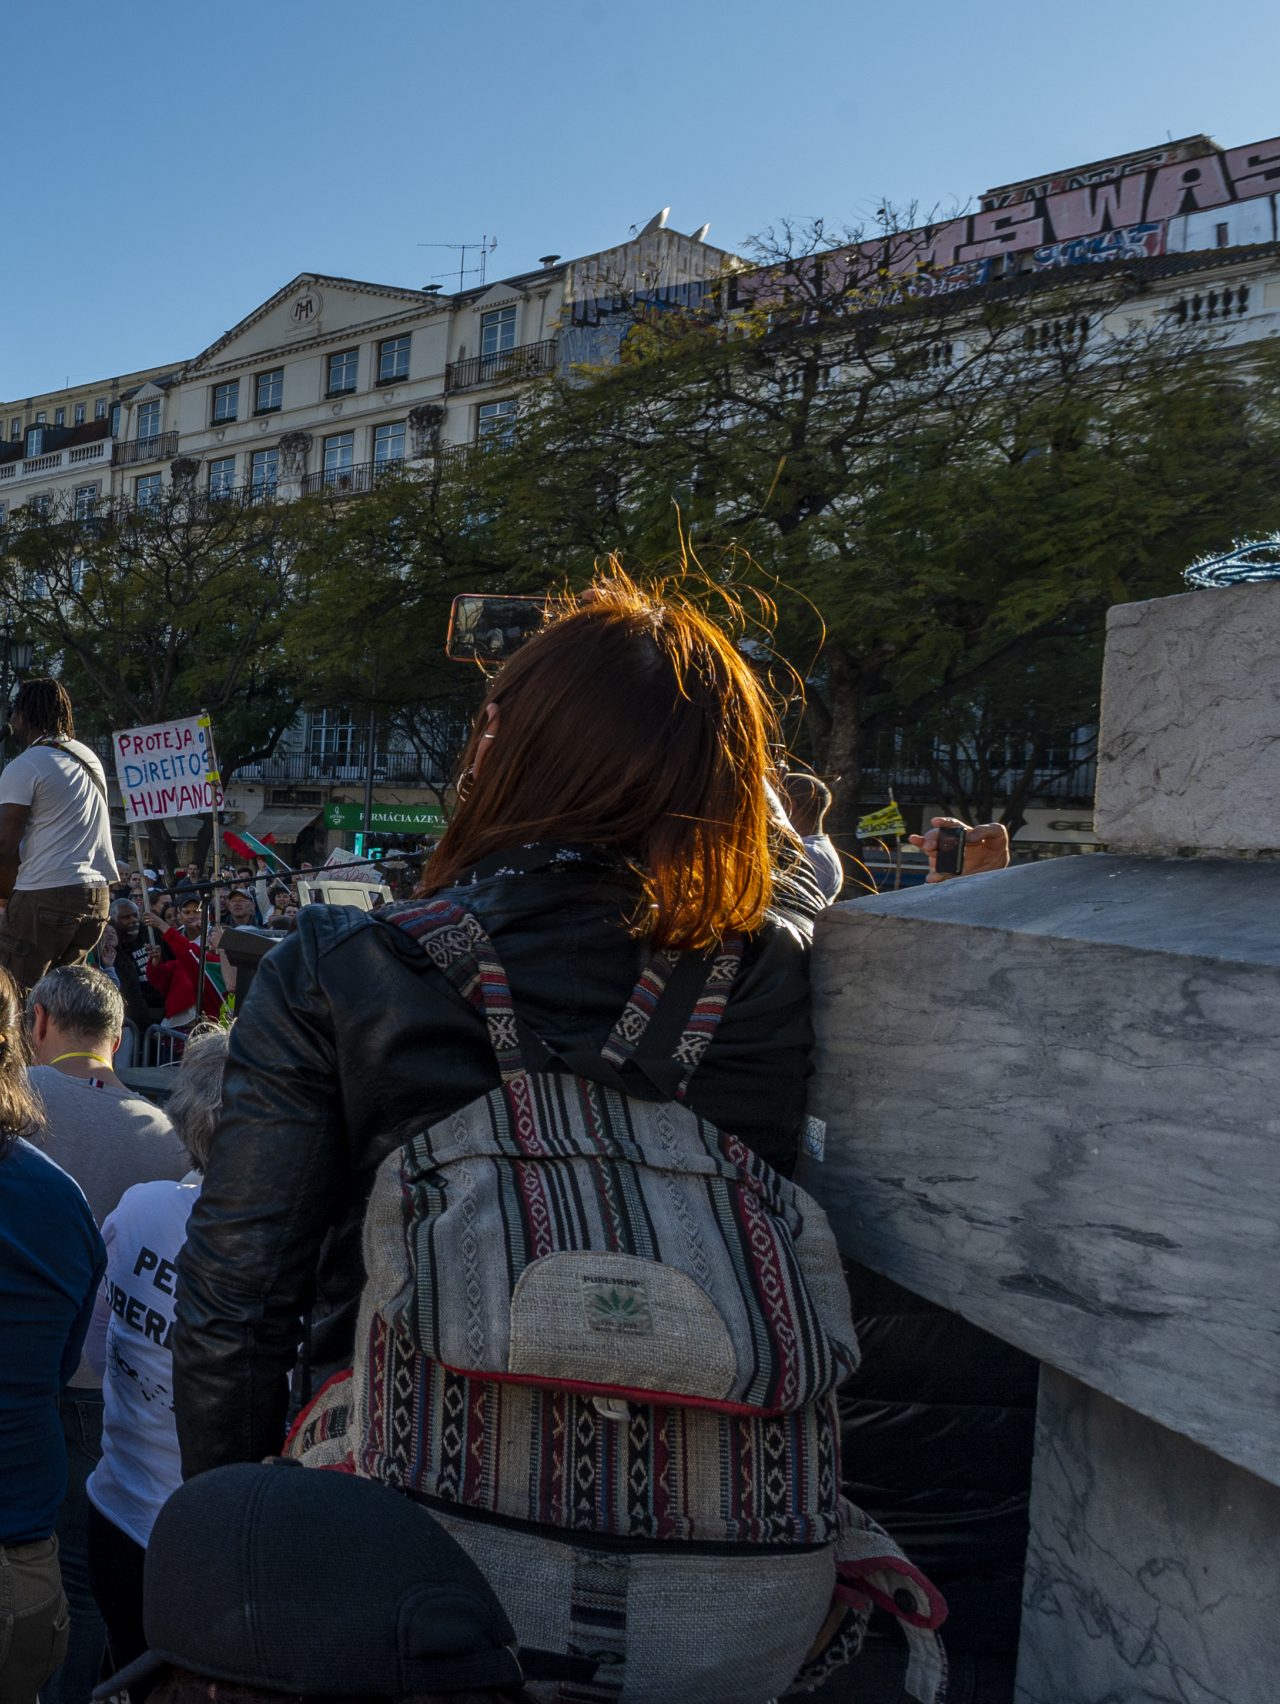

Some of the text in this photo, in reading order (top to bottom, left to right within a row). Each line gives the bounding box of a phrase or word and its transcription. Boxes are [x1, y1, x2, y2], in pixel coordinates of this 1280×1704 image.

[359, 812, 412, 822] FRMÁCIA
[1047, 820, 1094, 831] GE
[132, 1246, 178, 1297] PE
